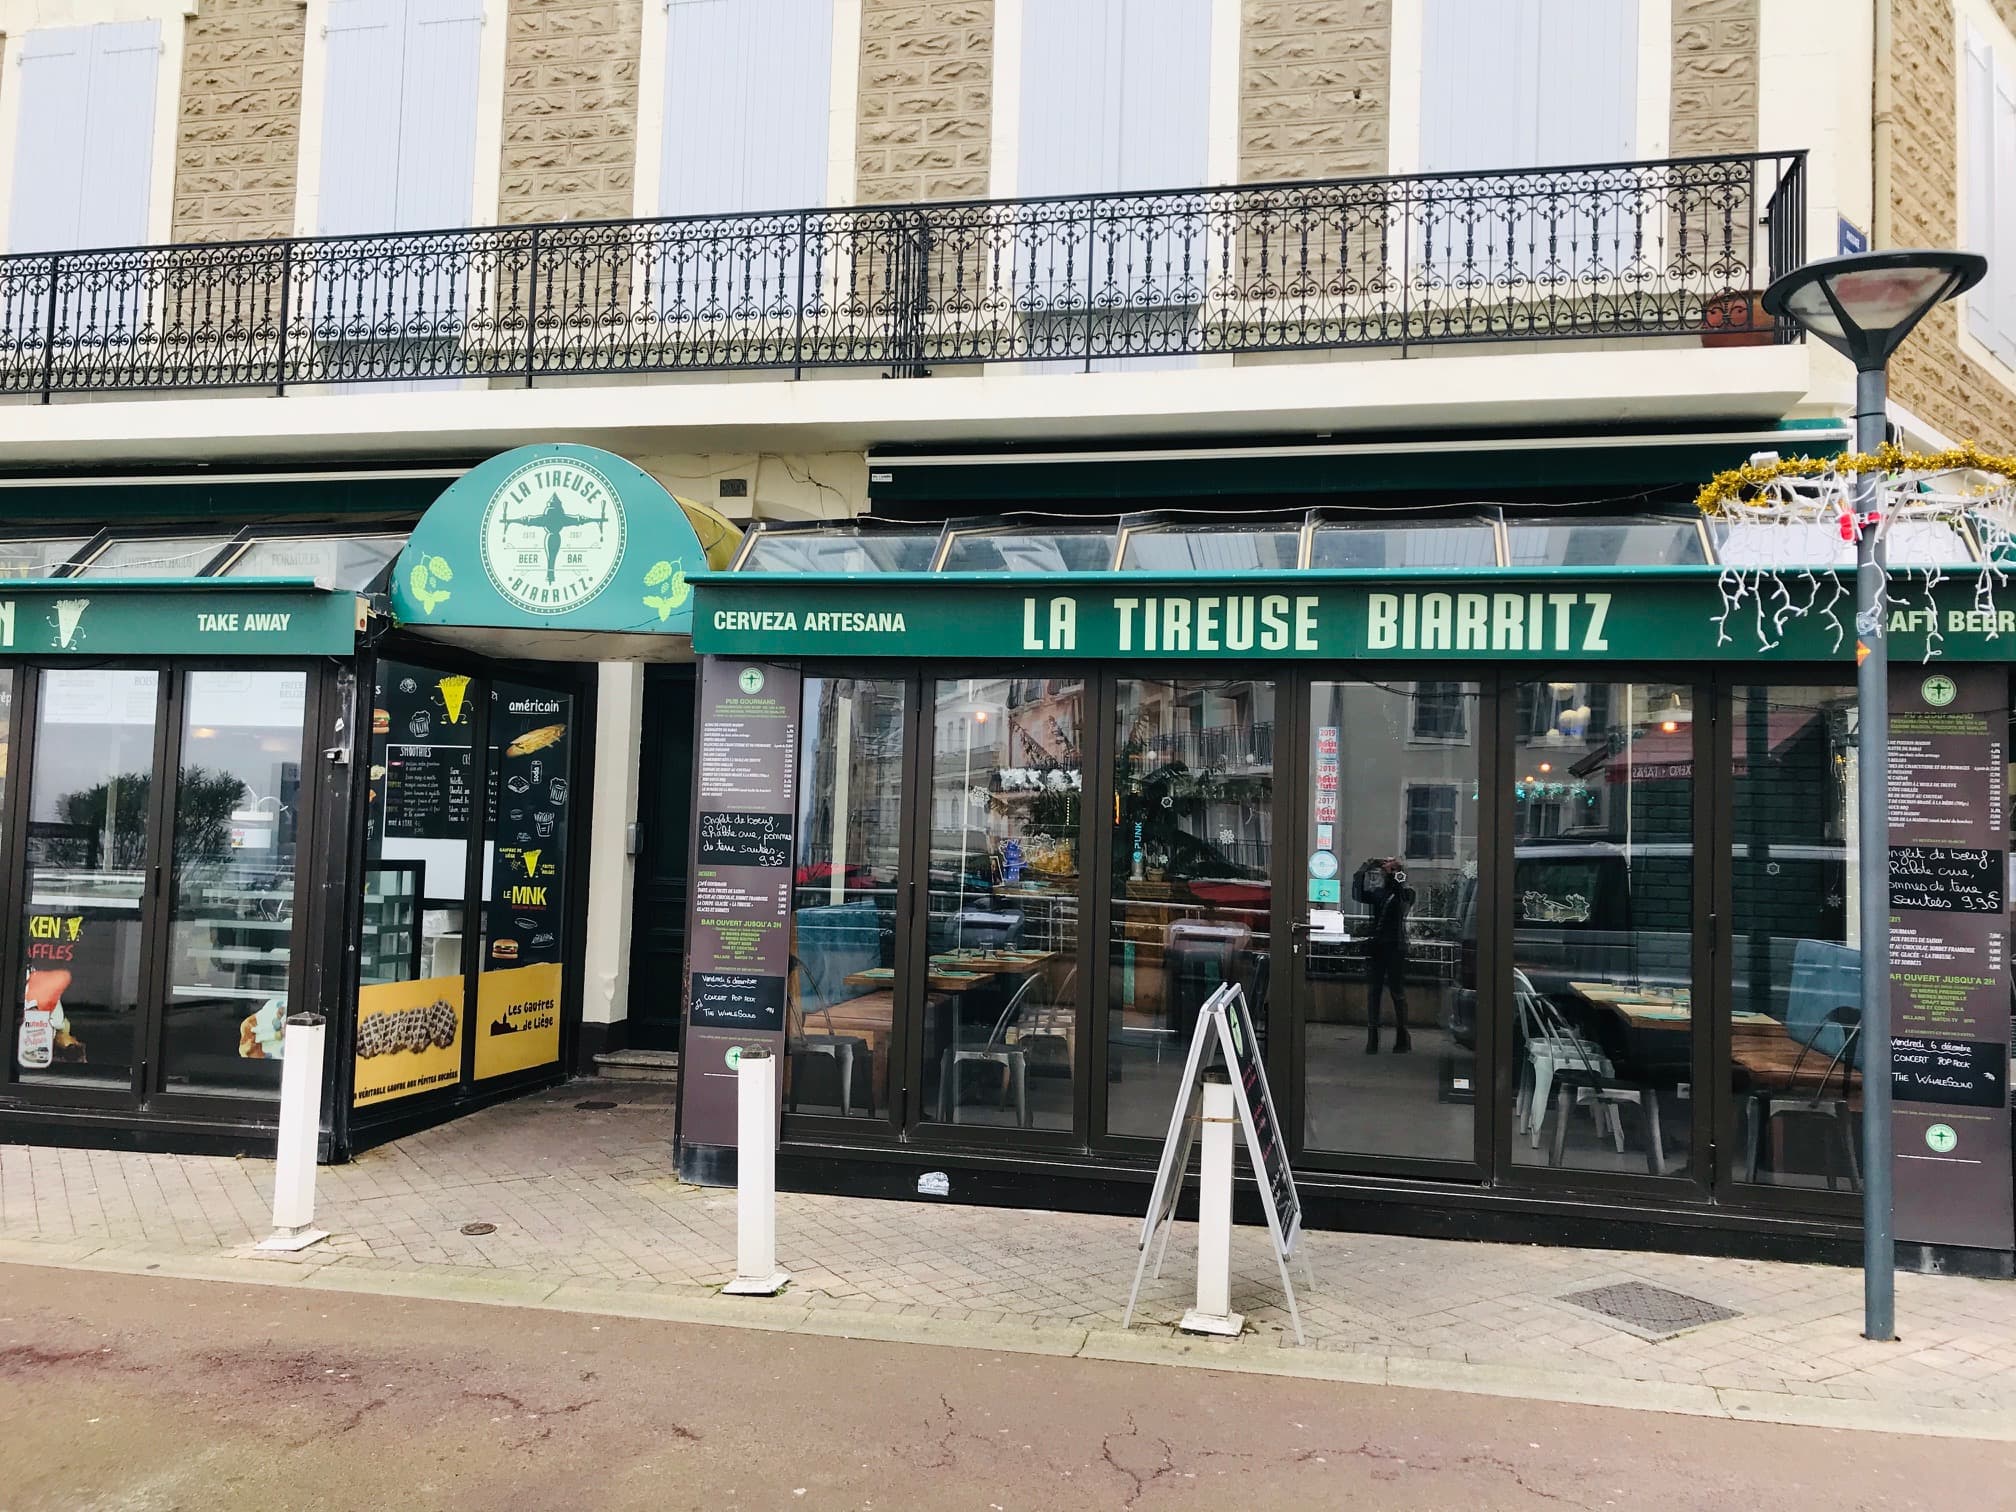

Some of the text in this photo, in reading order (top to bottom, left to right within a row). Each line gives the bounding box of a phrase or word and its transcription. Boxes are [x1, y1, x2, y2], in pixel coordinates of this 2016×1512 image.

[509, 469, 603, 505] LA TIREUSE
[518, 553, 583, 564] BEER BAR
[511, 577, 588, 603] BIARRITZ
[197, 613, 291, 632] TAKE AWAY
[713, 610, 906, 632] CERVEZA ARTESANA
[1023, 592, 1612, 651] LA TIREUSE BIARRITZ
[1949, 610, 2016, 632] BEER
[508, 699, 560, 712] américain
[400, 747, 431, 758] SMOOTHIES
[734, 813, 746, 824] de
[1134, 821, 1142, 849] PUNK
[703, 839, 714, 851] de
[1929, 848, 1945, 860] de
[1888, 879, 1982, 894] ommes de terre
[503, 886, 547, 905] LE MNK
[716, 919, 742, 927] OUVERT
[1889, 973, 1902, 981] AR
[1904, 973, 1941, 983] OUVERT
[1983, 977, 1996, 985] 2H
[508, 999, 554, 1016] Les Gaufres
[523, 1013, 553, 1030] de Liège
[1890, 1038, 1972, 1053] Vendredi 6 décembre
[1893, 1054, 1971, 1069] CONCERT POP ROCK
[1892, 1072, 1909, 1082] THE
